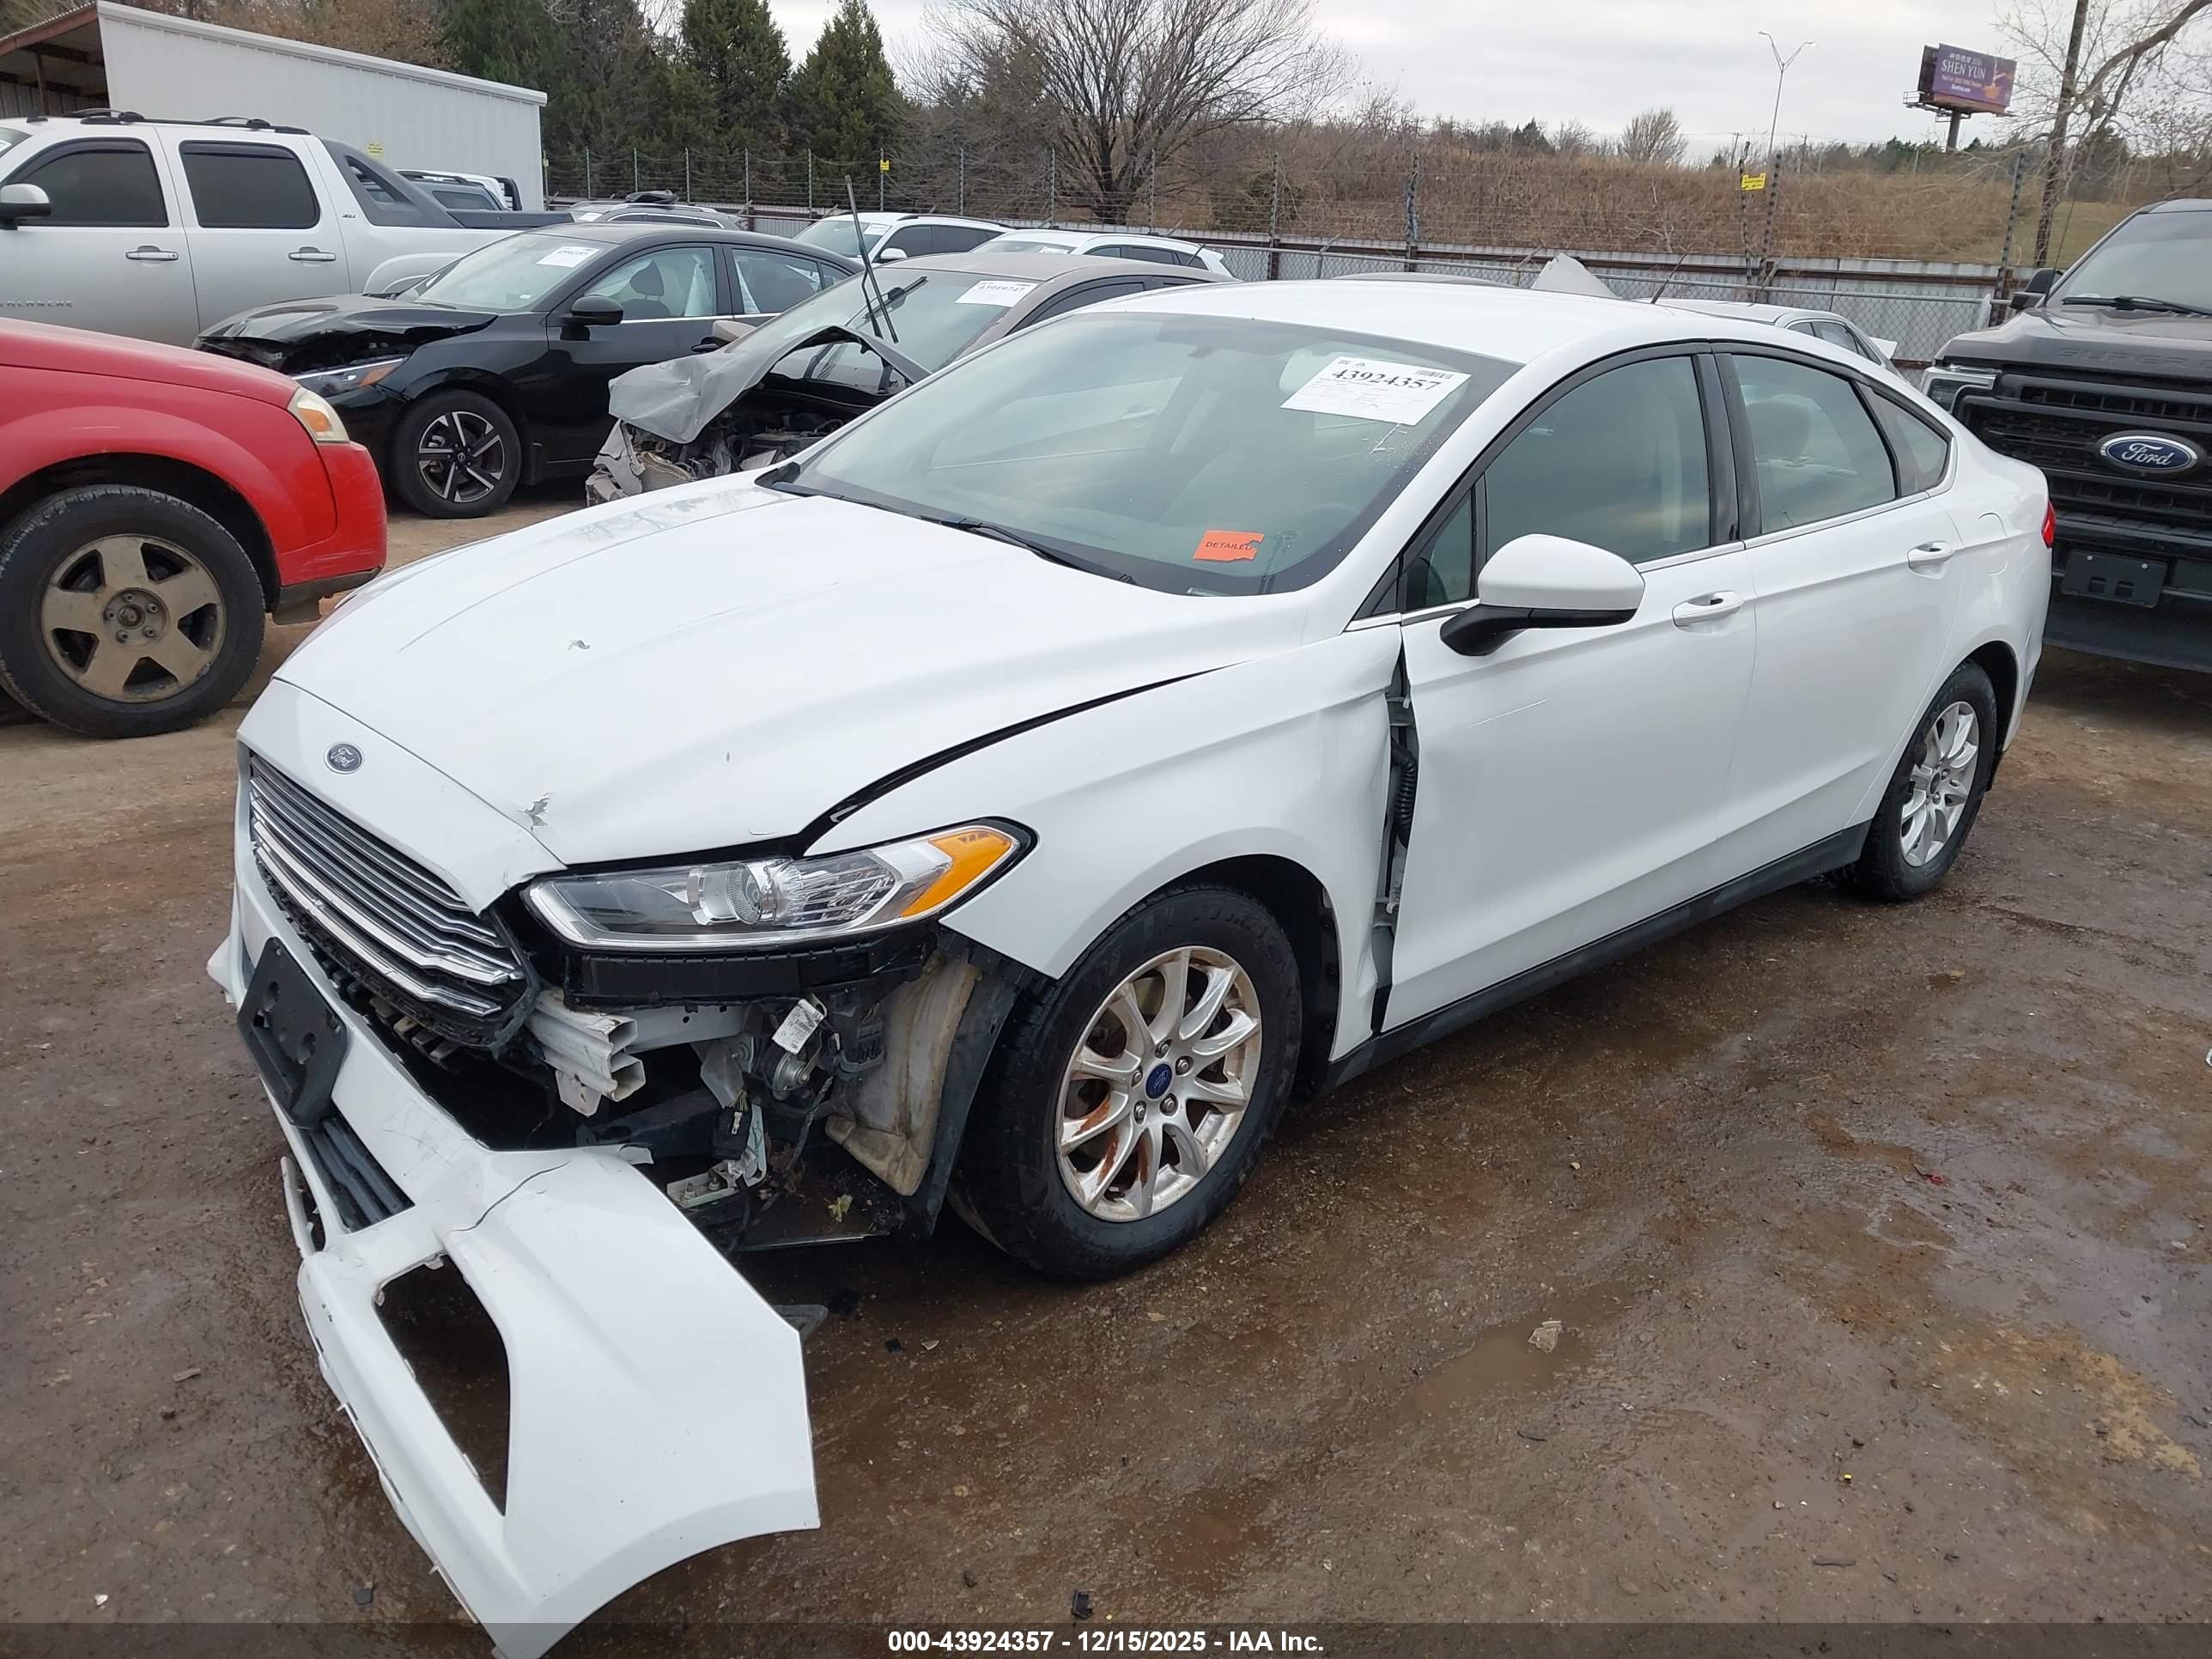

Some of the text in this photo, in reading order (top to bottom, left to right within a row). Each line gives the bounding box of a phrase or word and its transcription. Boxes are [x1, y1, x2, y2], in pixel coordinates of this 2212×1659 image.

[1942, 59, 1966, 76] SHEN
[1968, 65, 1987, 81] YUN
[2057, 348, 2191, 368] SUPER
[1333, 369, 1443, 390] 43924357
[2121, 442, 2175, 465] Ford
[330, 747, 356, 768] Ford
